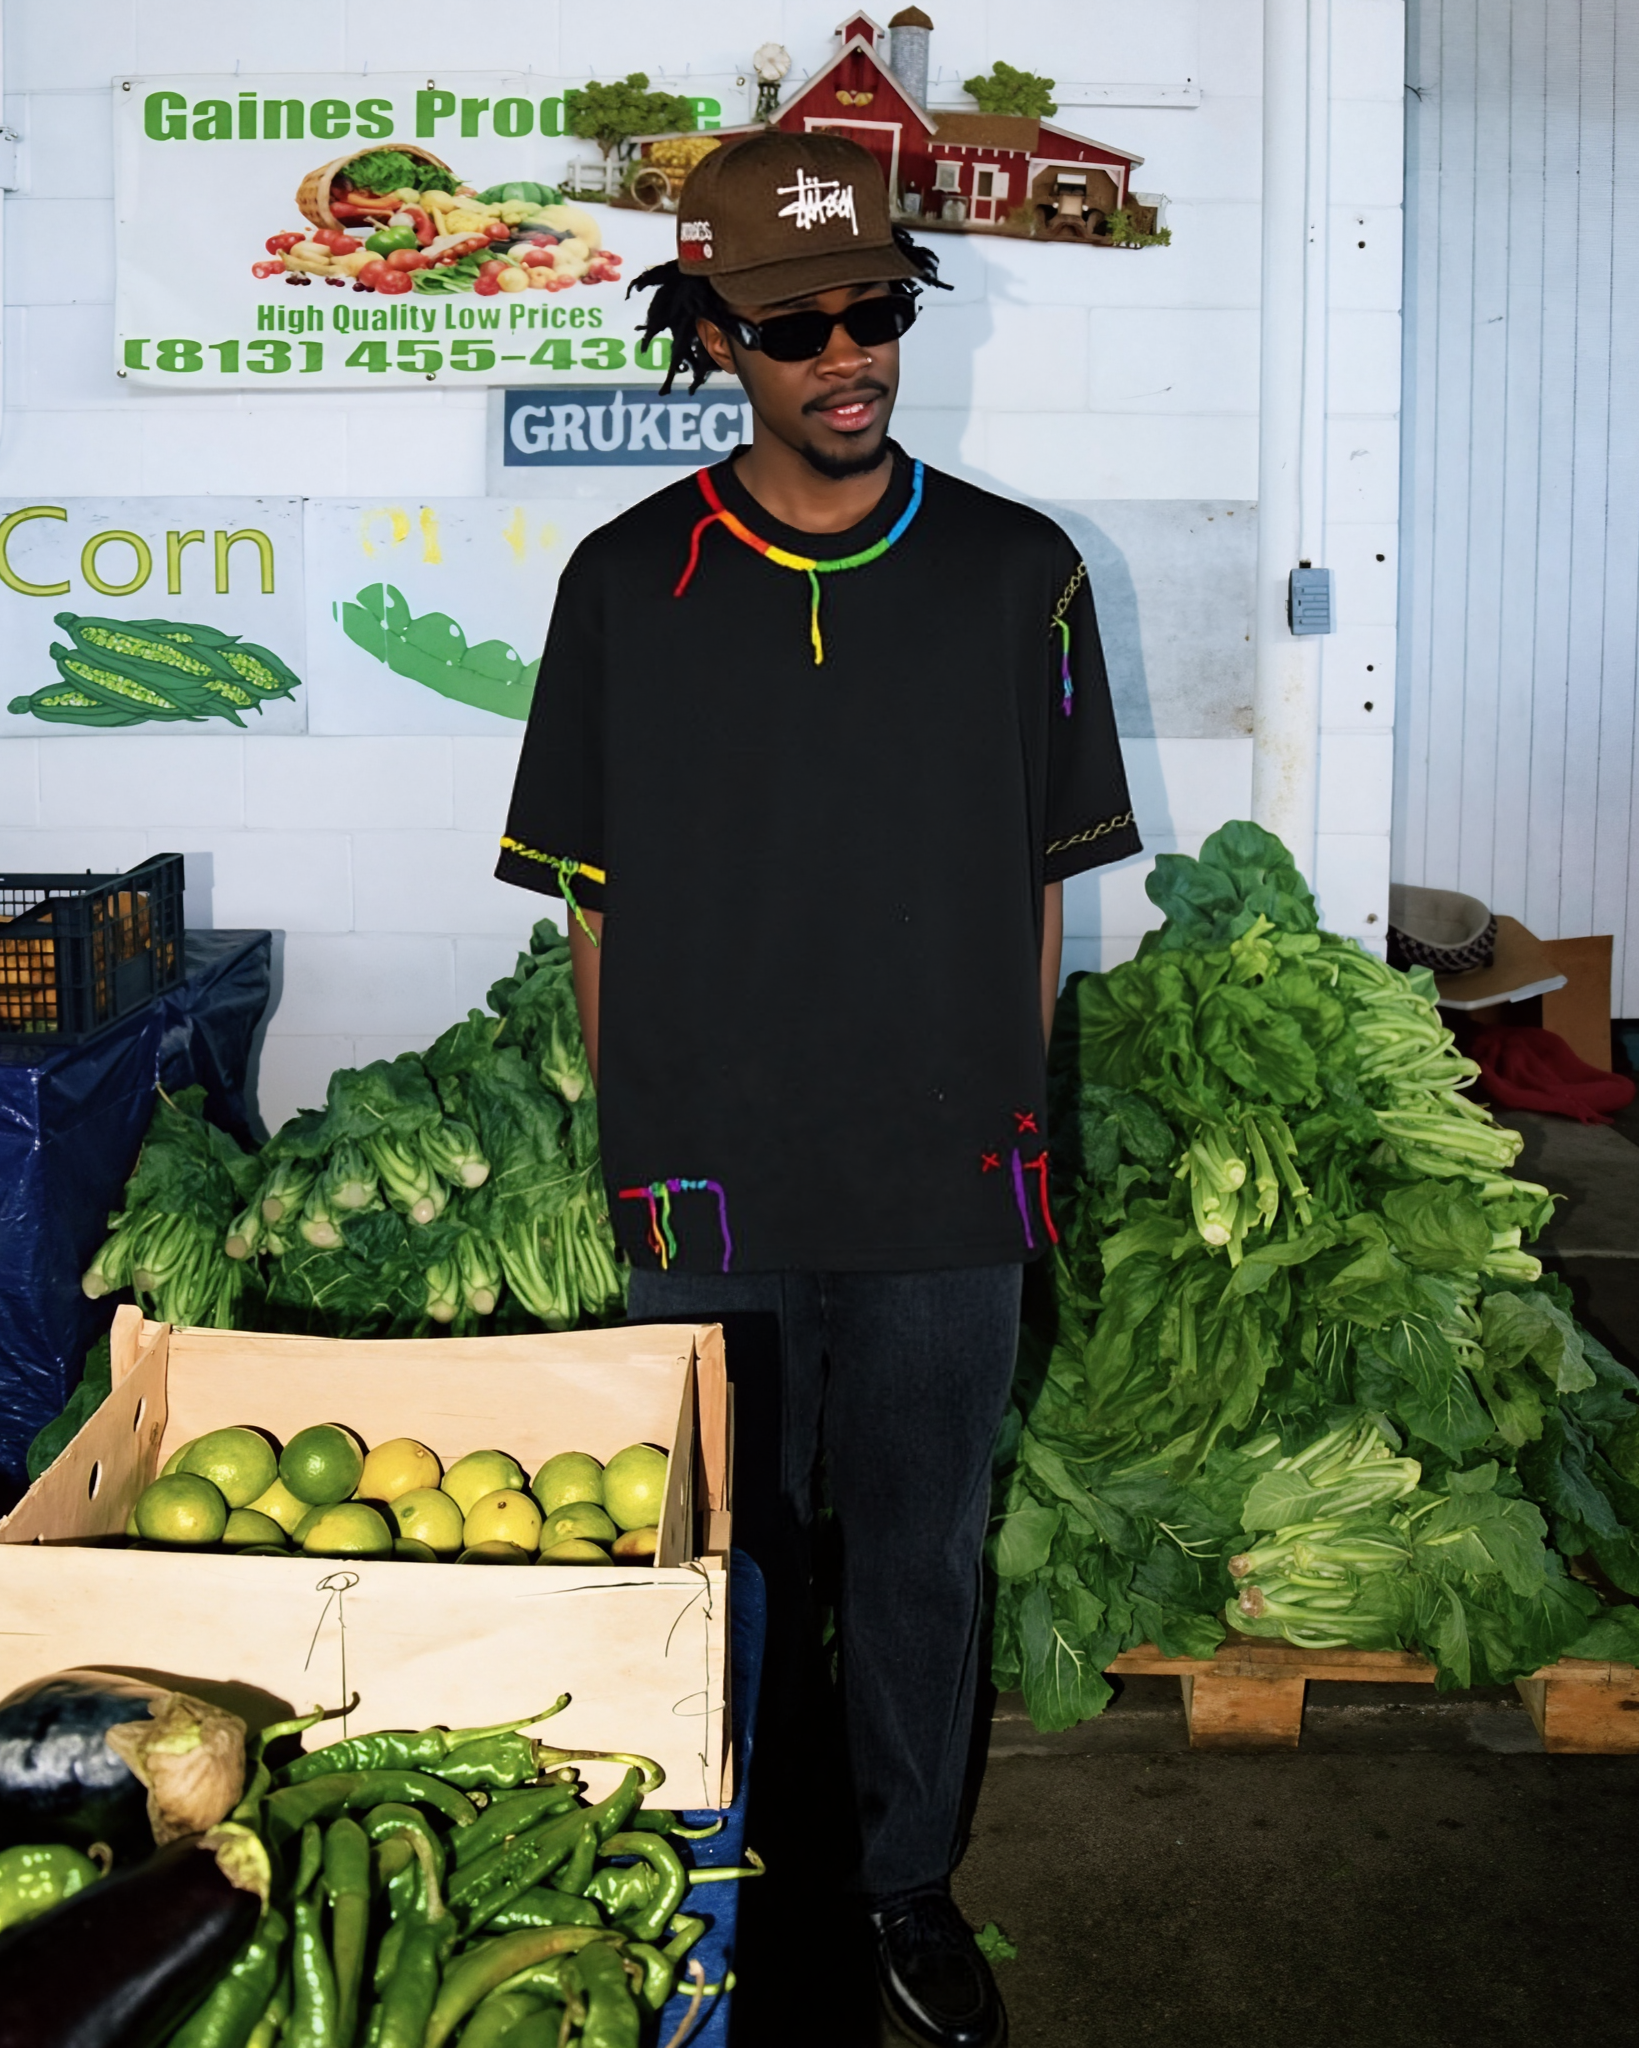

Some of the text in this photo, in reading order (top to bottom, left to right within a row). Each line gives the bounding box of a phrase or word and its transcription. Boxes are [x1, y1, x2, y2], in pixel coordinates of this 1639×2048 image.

[143, 89, 721, 141] Gaines Prode
[256, 302, 603, 335] High Quality Low Prices
[344, 336, 674, 373] 455-430
[509, 389, 754, 455] GRUKEC
[0, 505, 275, 596] Corn
